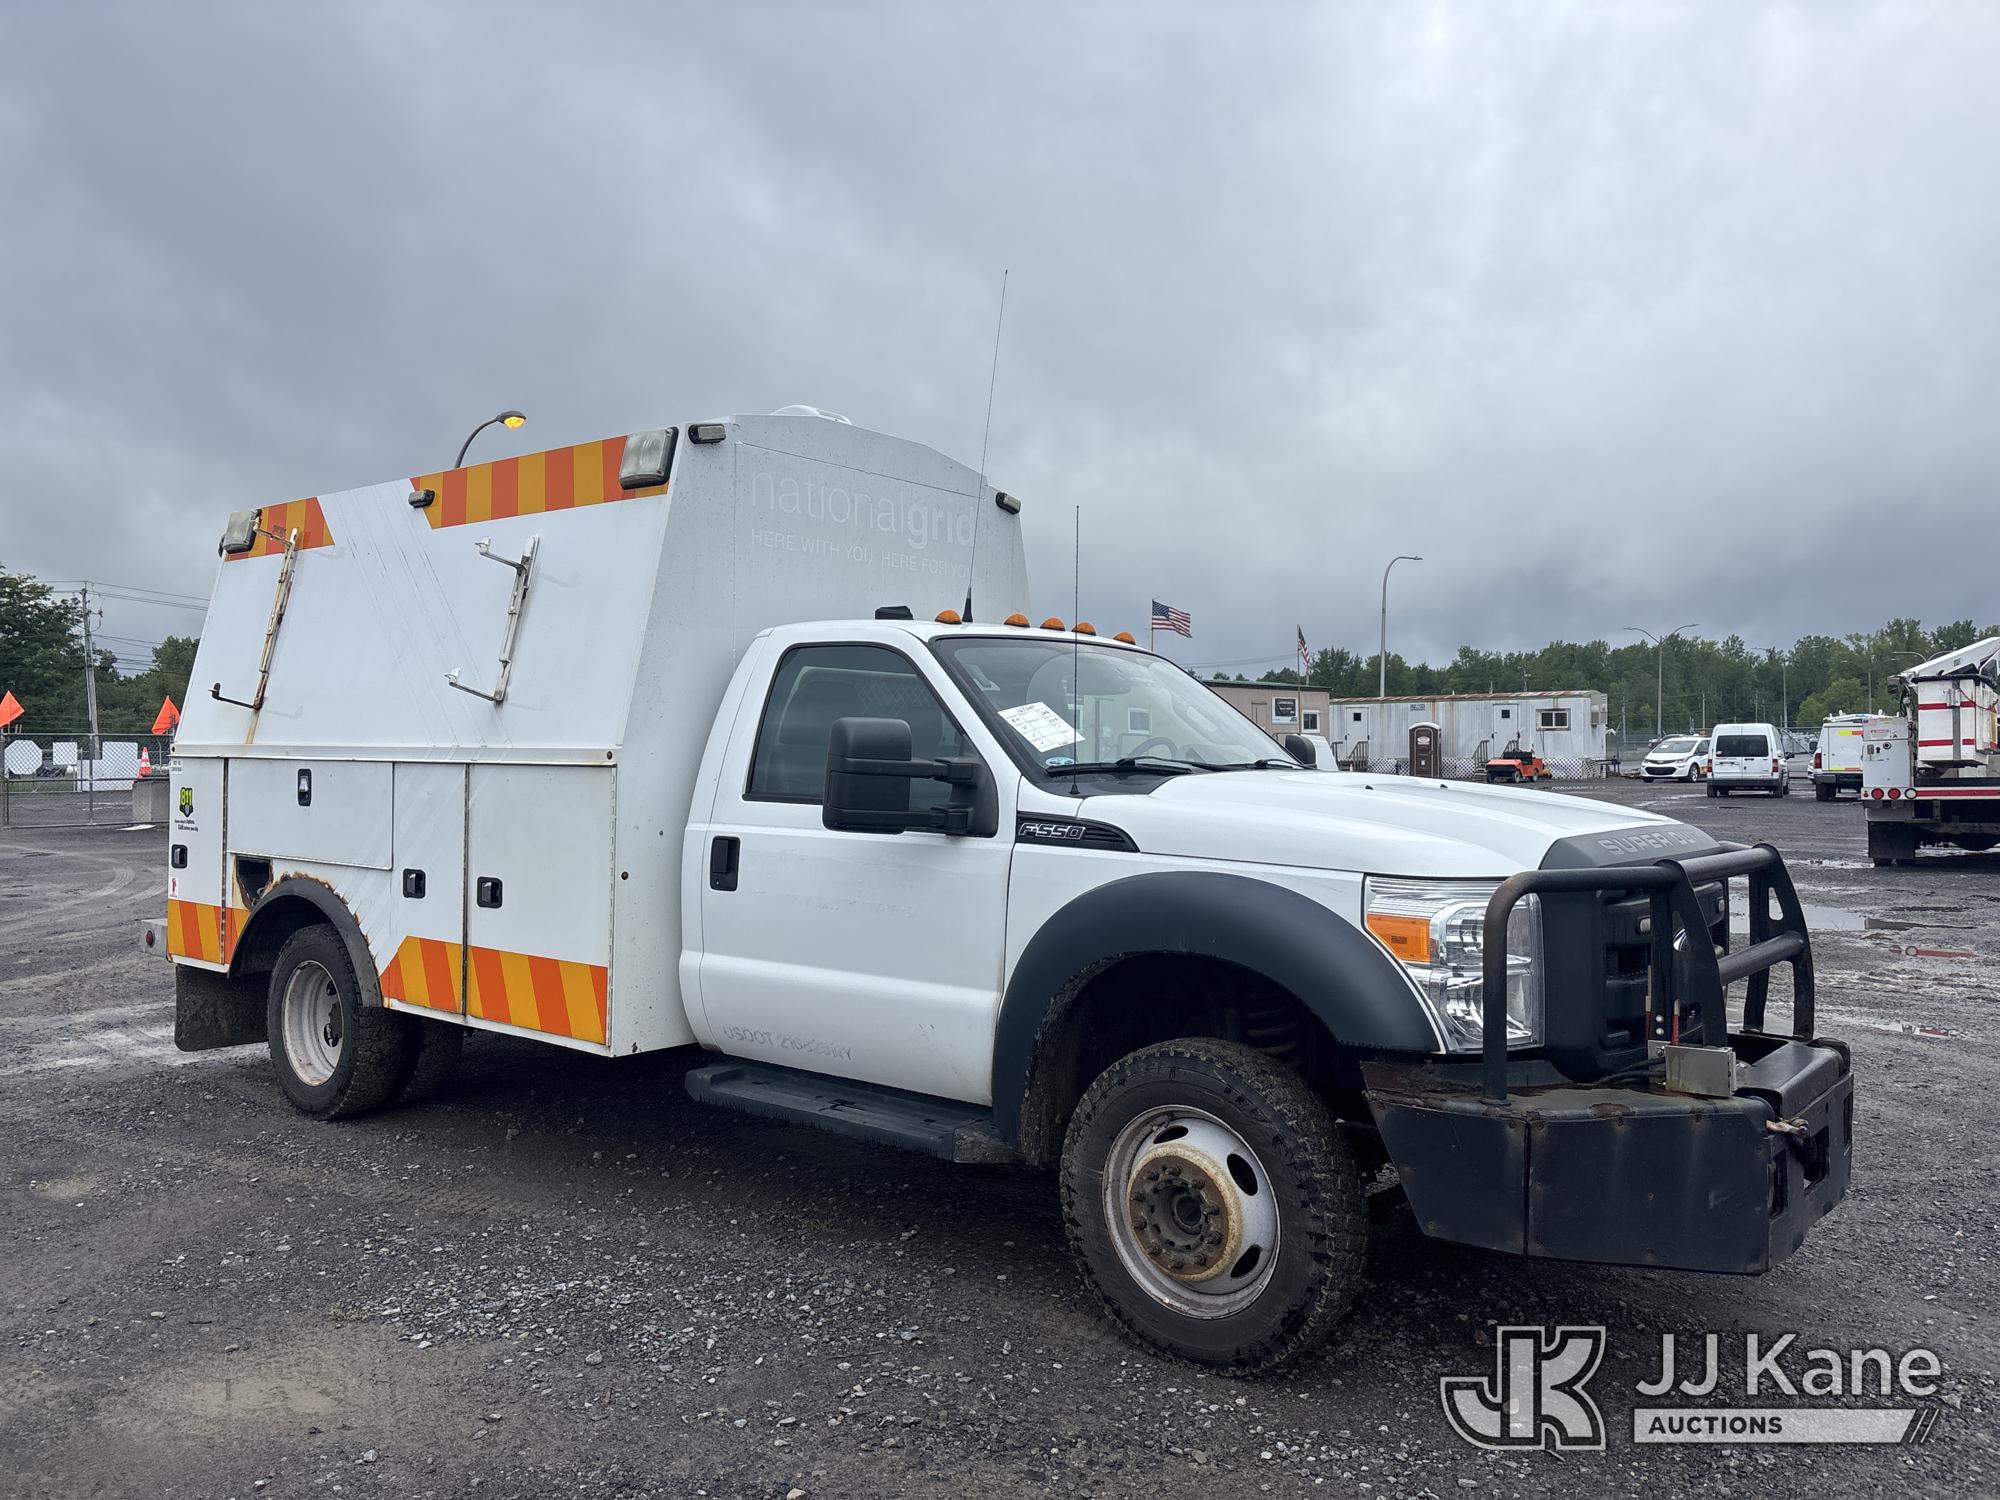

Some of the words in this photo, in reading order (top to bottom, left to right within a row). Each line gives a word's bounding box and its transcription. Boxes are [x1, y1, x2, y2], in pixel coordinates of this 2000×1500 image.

[752, 471, 976, 550] nationalgrid
[751, 528, 796, 552] HERE
[800, 537, 840, 558] WITH
[881, 551, 918, 572] HERE
[921, 557, 948, 577] FOR
[180, 787, 193, 806] 811
[1018, 822, 1086, 840] F-550
[1598, 833, 1673, 855] SUPER
[1667, 831, 1697, 845] DU
